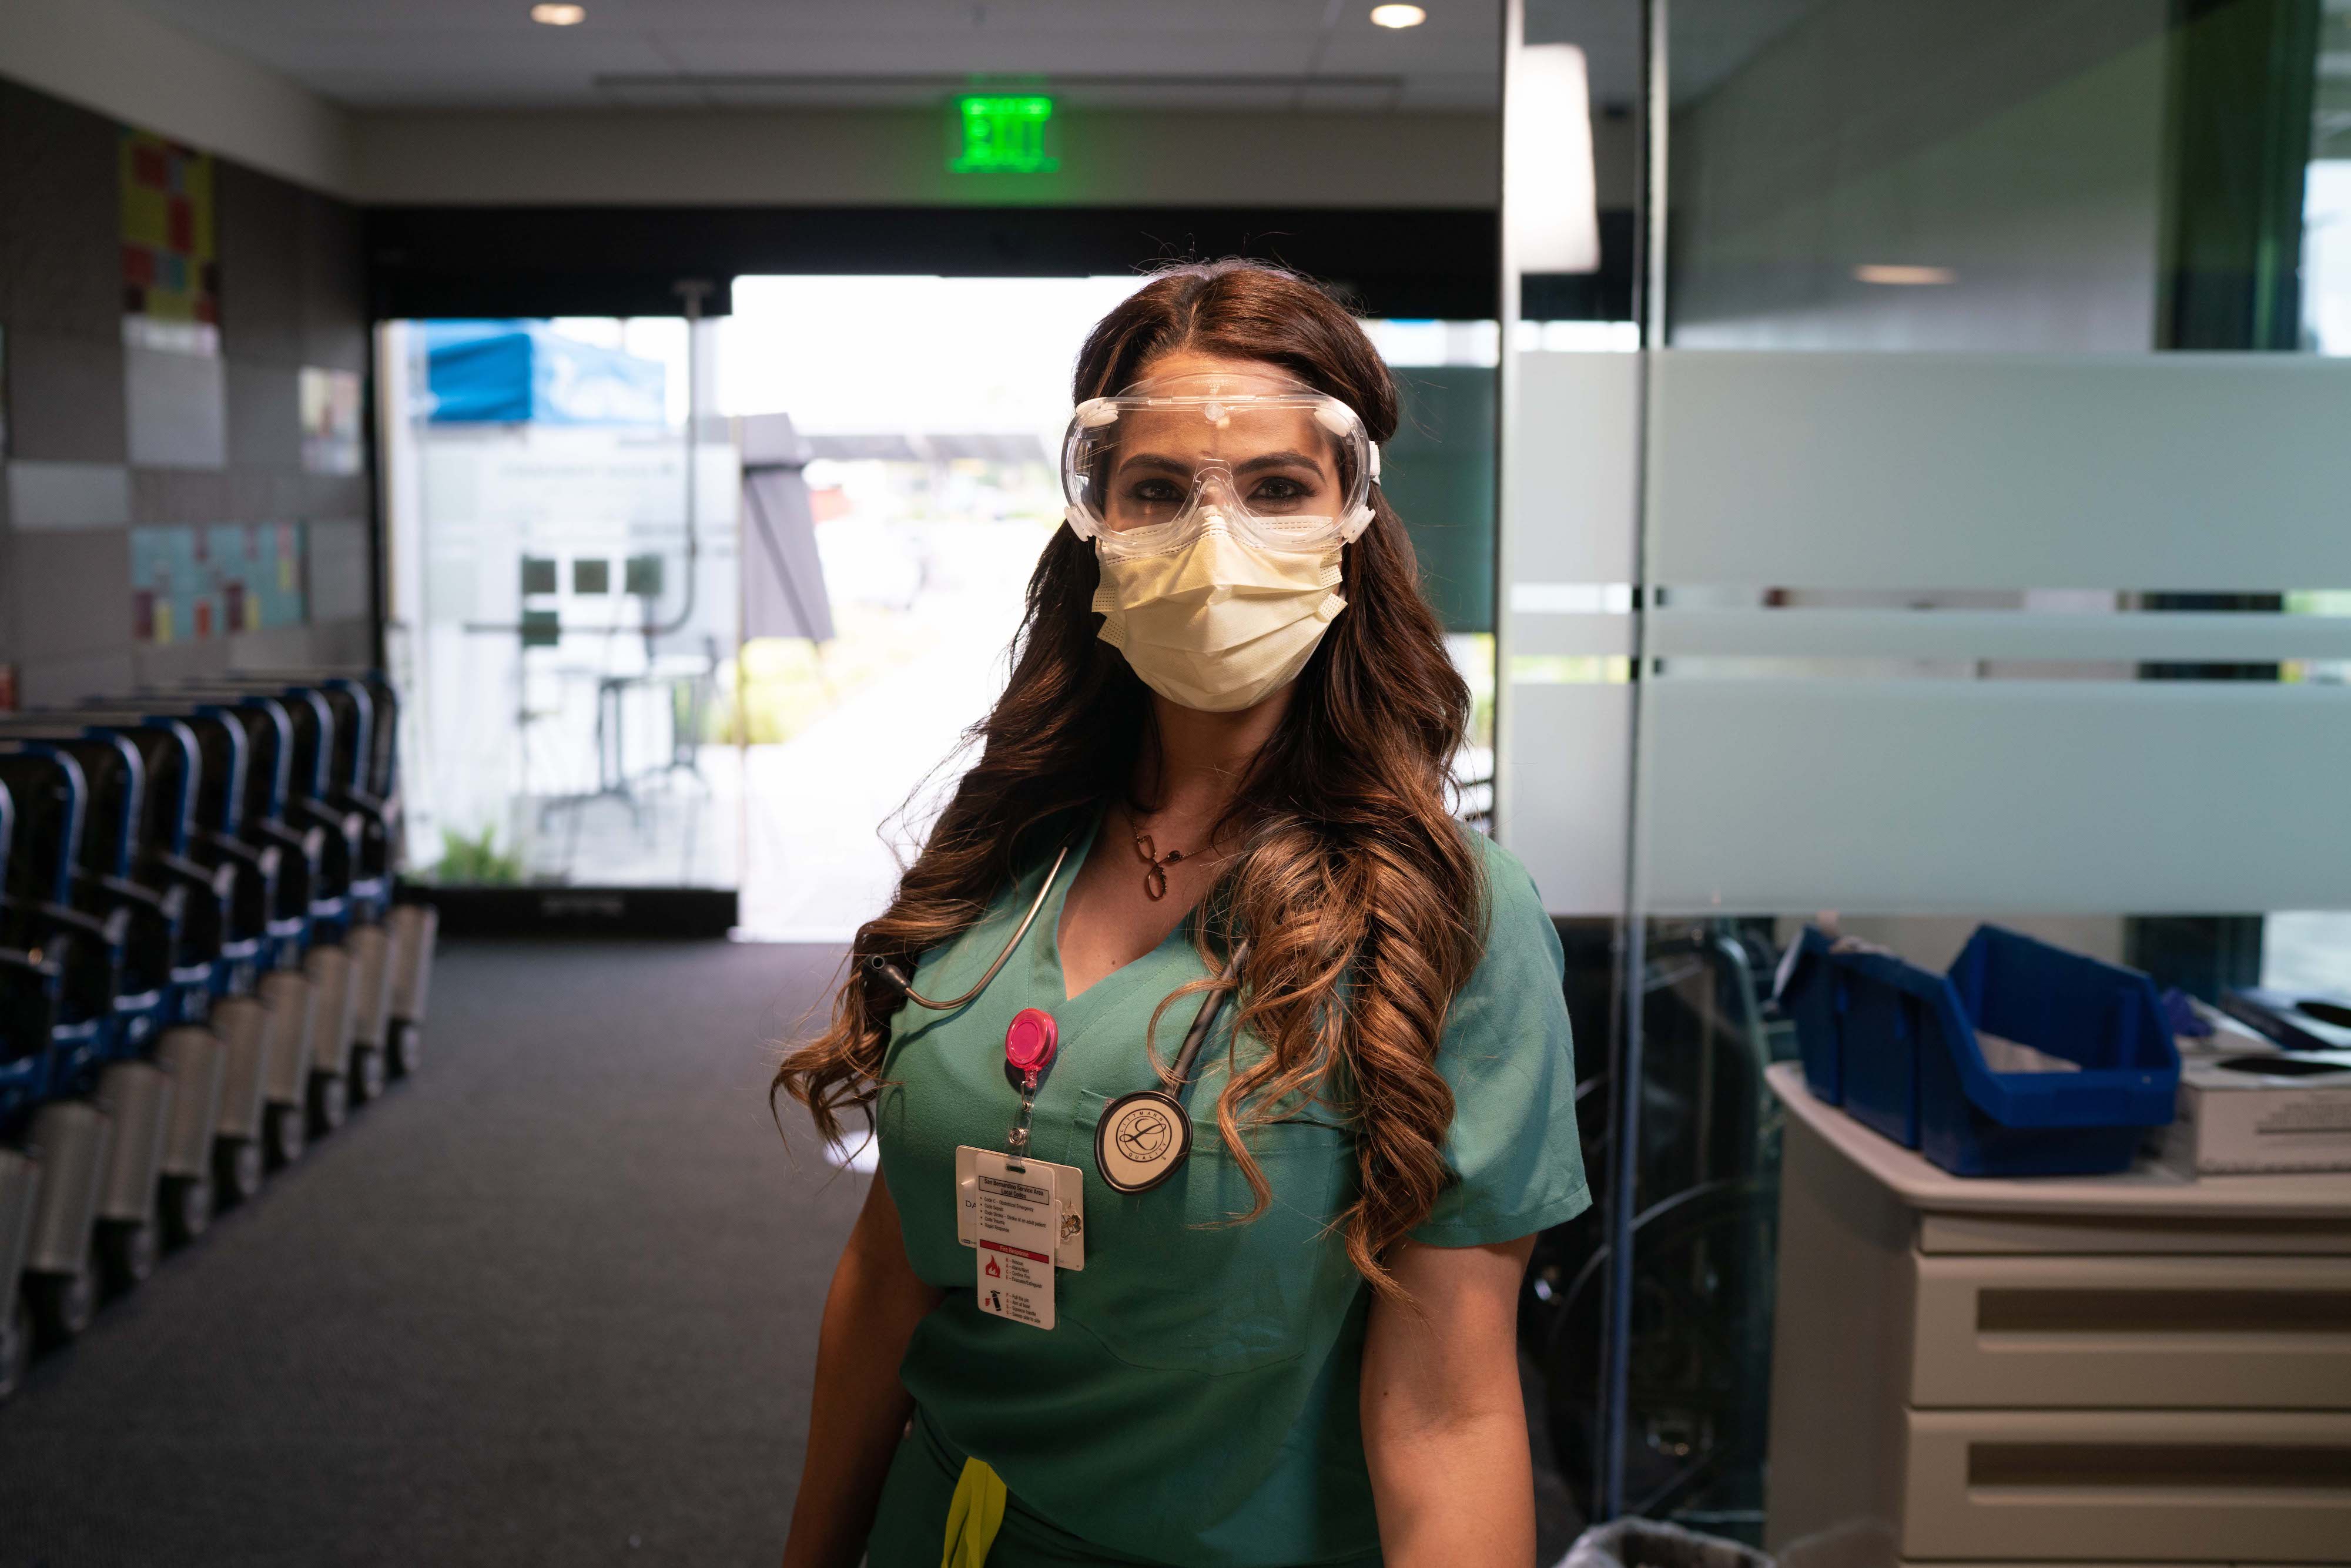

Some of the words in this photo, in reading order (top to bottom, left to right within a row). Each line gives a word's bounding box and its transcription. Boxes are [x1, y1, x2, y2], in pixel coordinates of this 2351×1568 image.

[1119, 1111, 1164, 1133] LITTMANN
[1128, 1143, 1167, 1160] QUALITY
[993, 1181, 1016, 1190] Bernardino
[1017, 1185, 1033, 1194] Service
[1016, 1204, 1033, 1212] Emergency
[1009, 1248, 1029, 1257] Response
